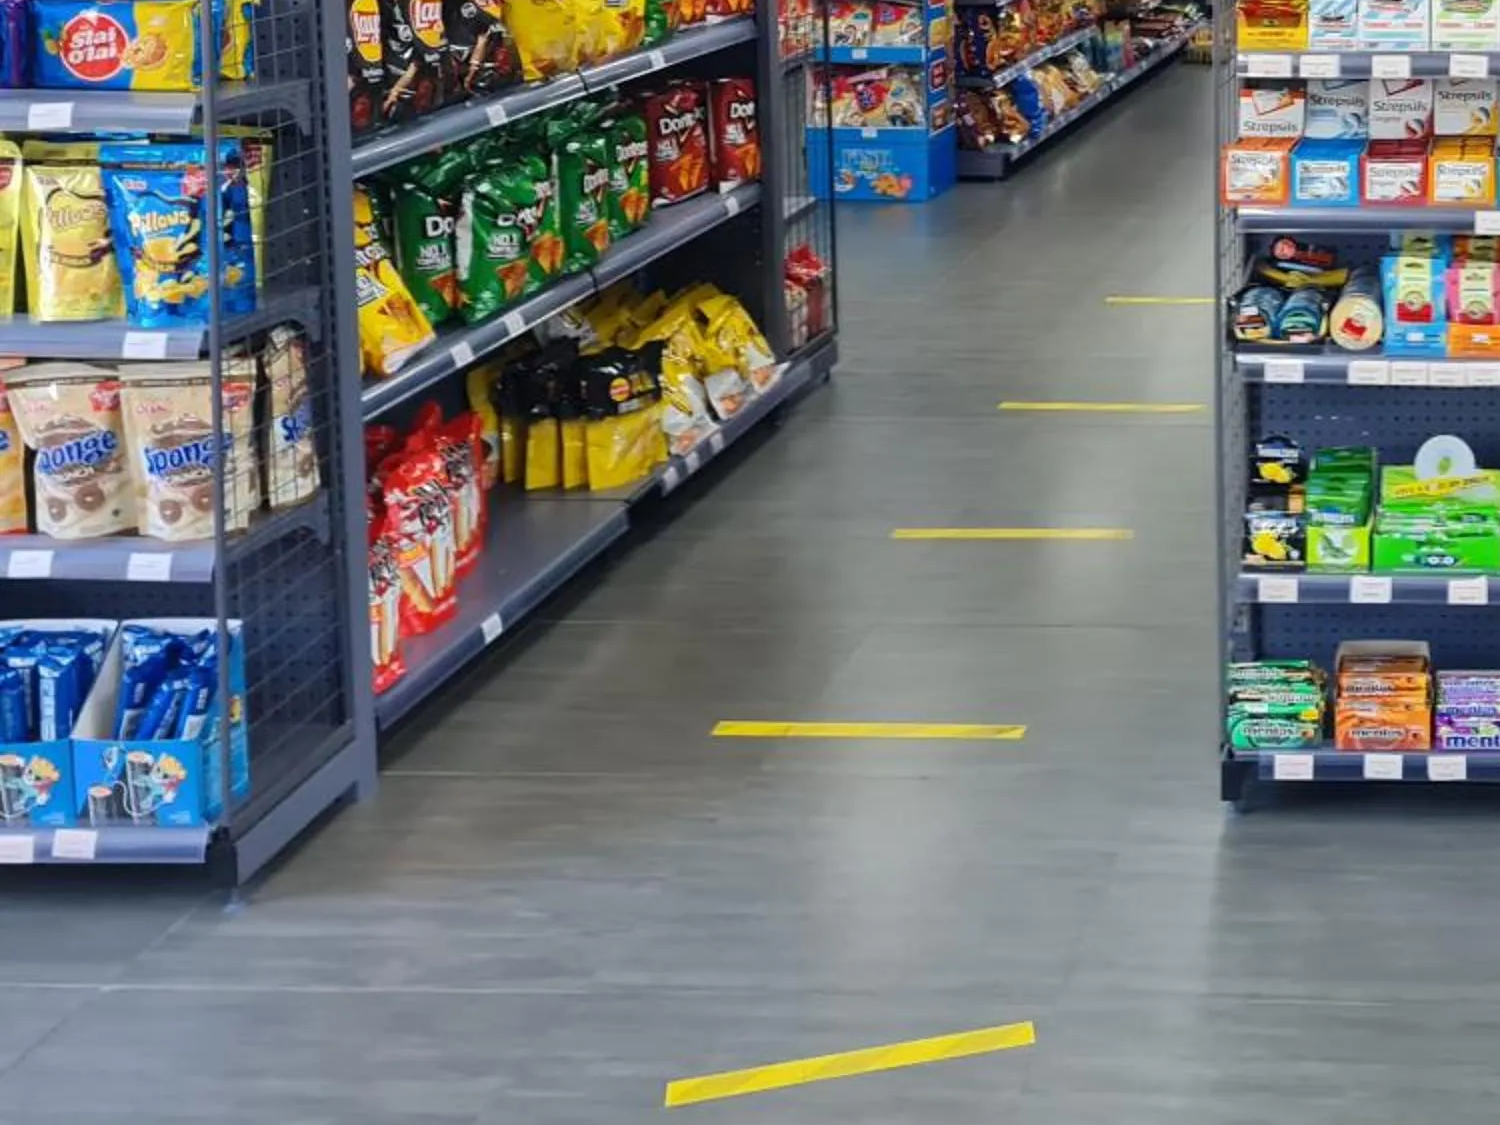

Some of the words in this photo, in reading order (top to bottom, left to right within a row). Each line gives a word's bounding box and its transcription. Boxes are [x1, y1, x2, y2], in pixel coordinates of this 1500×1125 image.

[1310, 93, 1366, 109] Strepsils
[1438, 90, 1493, 104] Strepsils
[1372, 100, 1429, 115] Strepsils
[1243, 121, 1299, 134] Strepsils
[127, 209, 192, 236] Pillows
[38, 429, 119, 474] ponge
